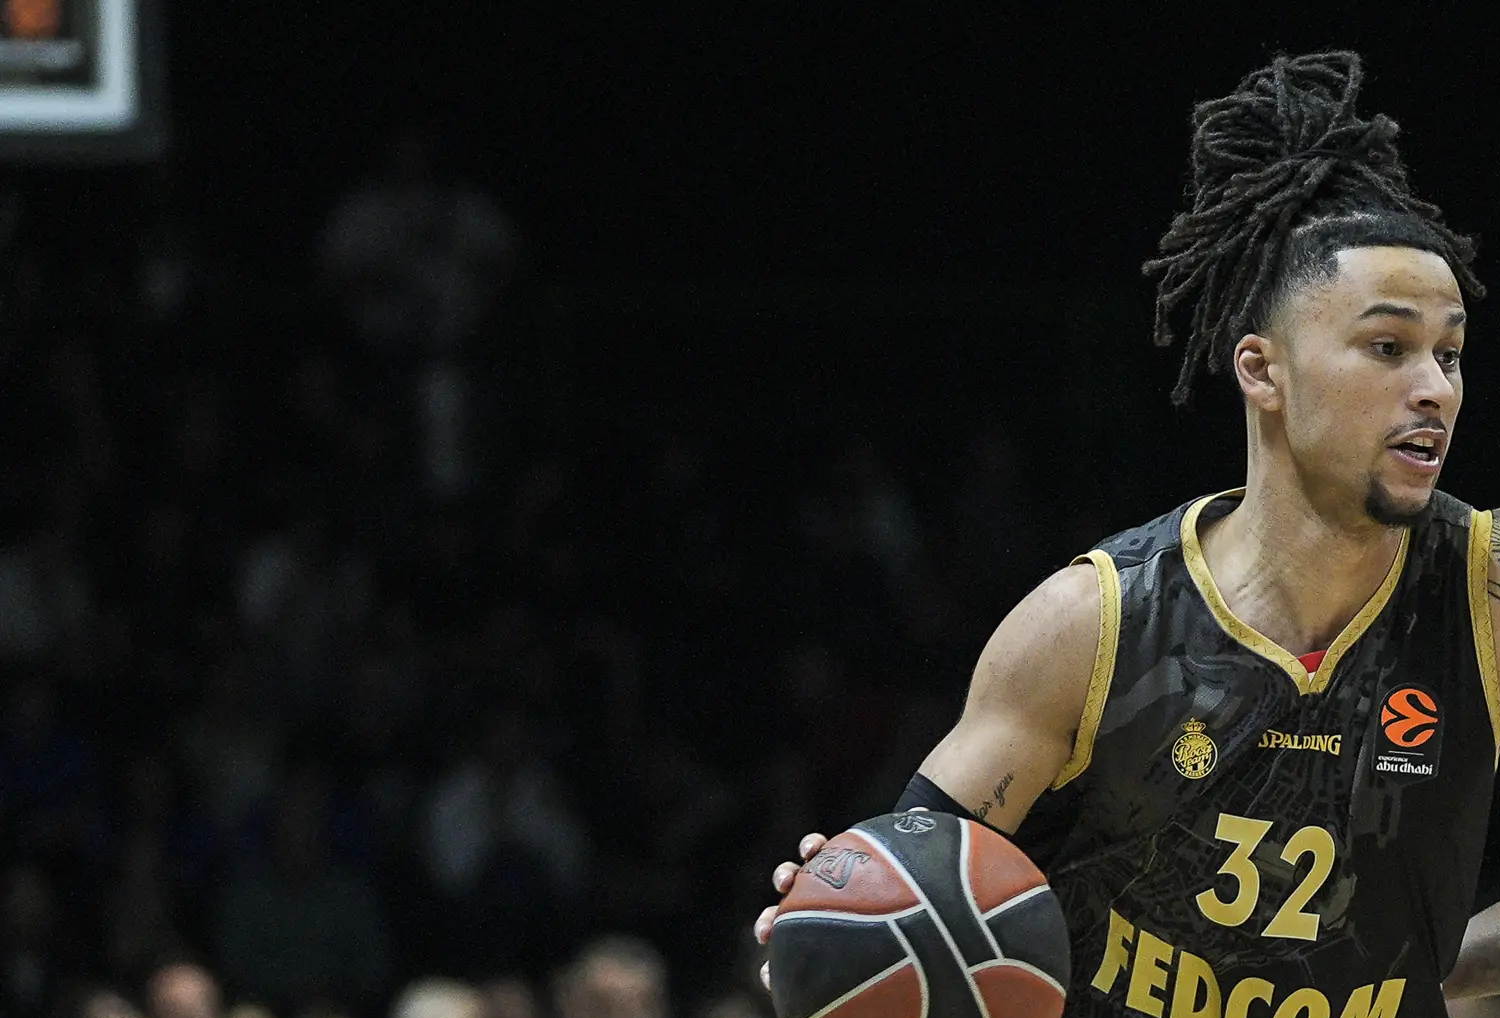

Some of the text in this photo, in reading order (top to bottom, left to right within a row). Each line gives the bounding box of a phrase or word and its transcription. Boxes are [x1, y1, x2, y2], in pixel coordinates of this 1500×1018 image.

[1258, 729, 1342, 756] SPALDING
[1376, 761, 1433, 775] abu dhabi
[1195, 812, 1336, 942] 32
